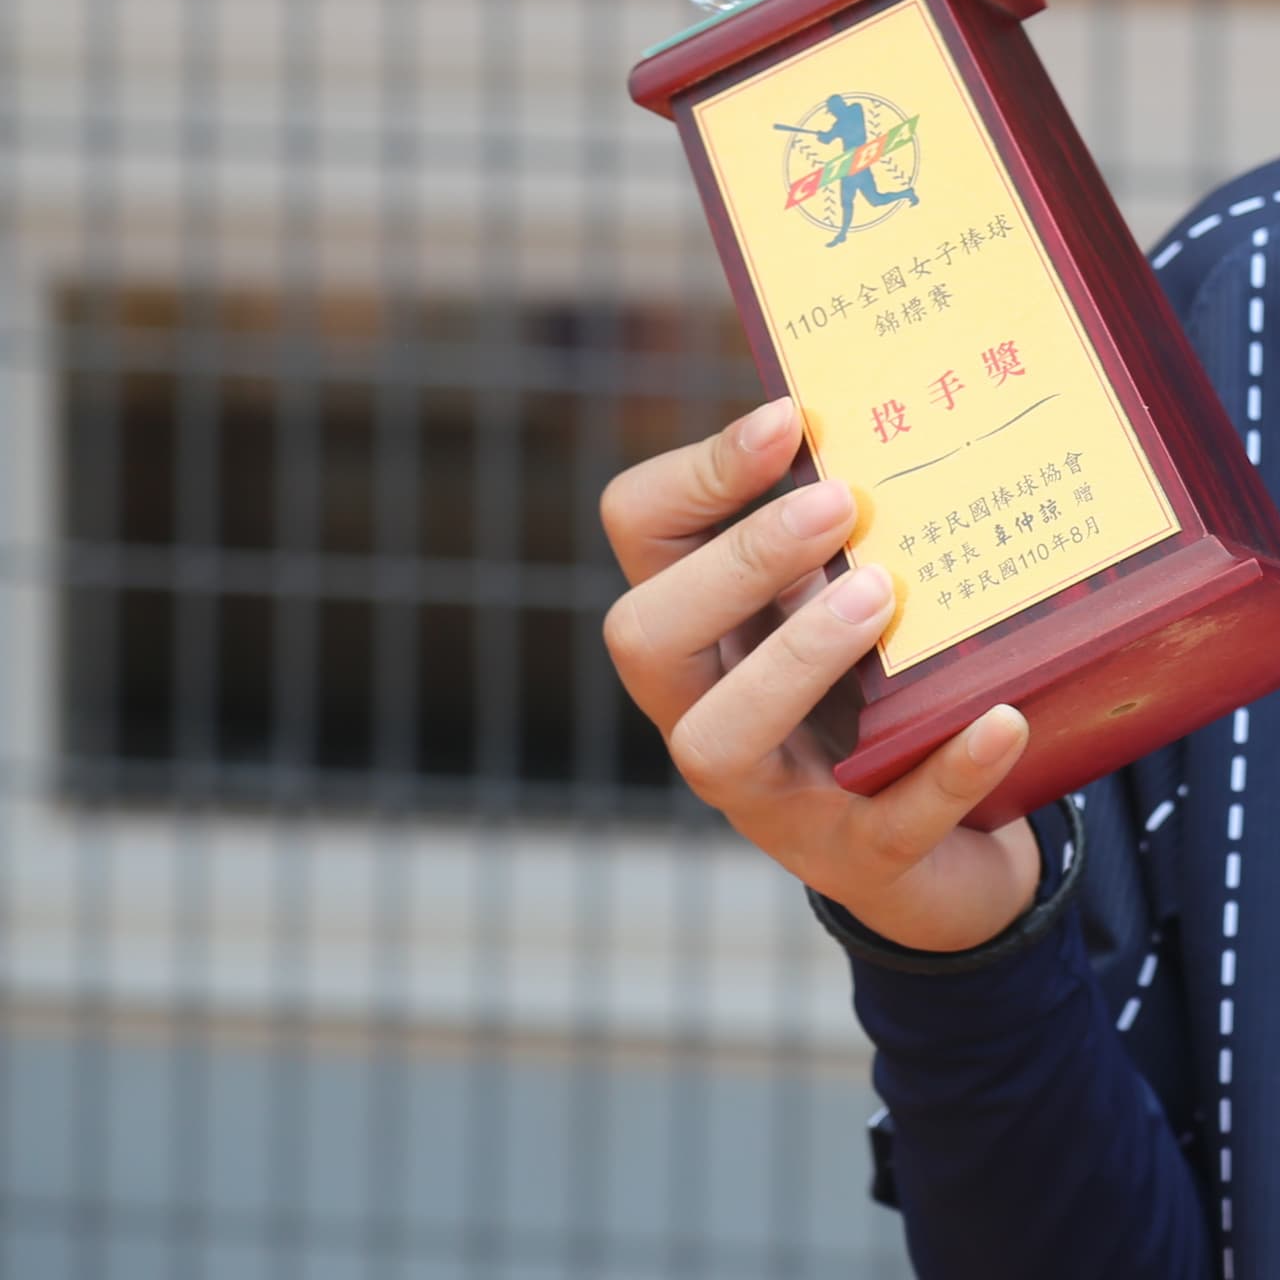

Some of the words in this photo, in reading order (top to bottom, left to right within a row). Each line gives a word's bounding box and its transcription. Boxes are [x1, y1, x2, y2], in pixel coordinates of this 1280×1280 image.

[785, 214, 1014, 339] 110年全國女子棒球
[873, 283, 954, 337] 錦標賽
[898, 451, 1084, 556] 中華民國棒球協會
[917, 542, 981, 583] 理事長
[936, 516, 1101, 611] 中華民國110年8月
